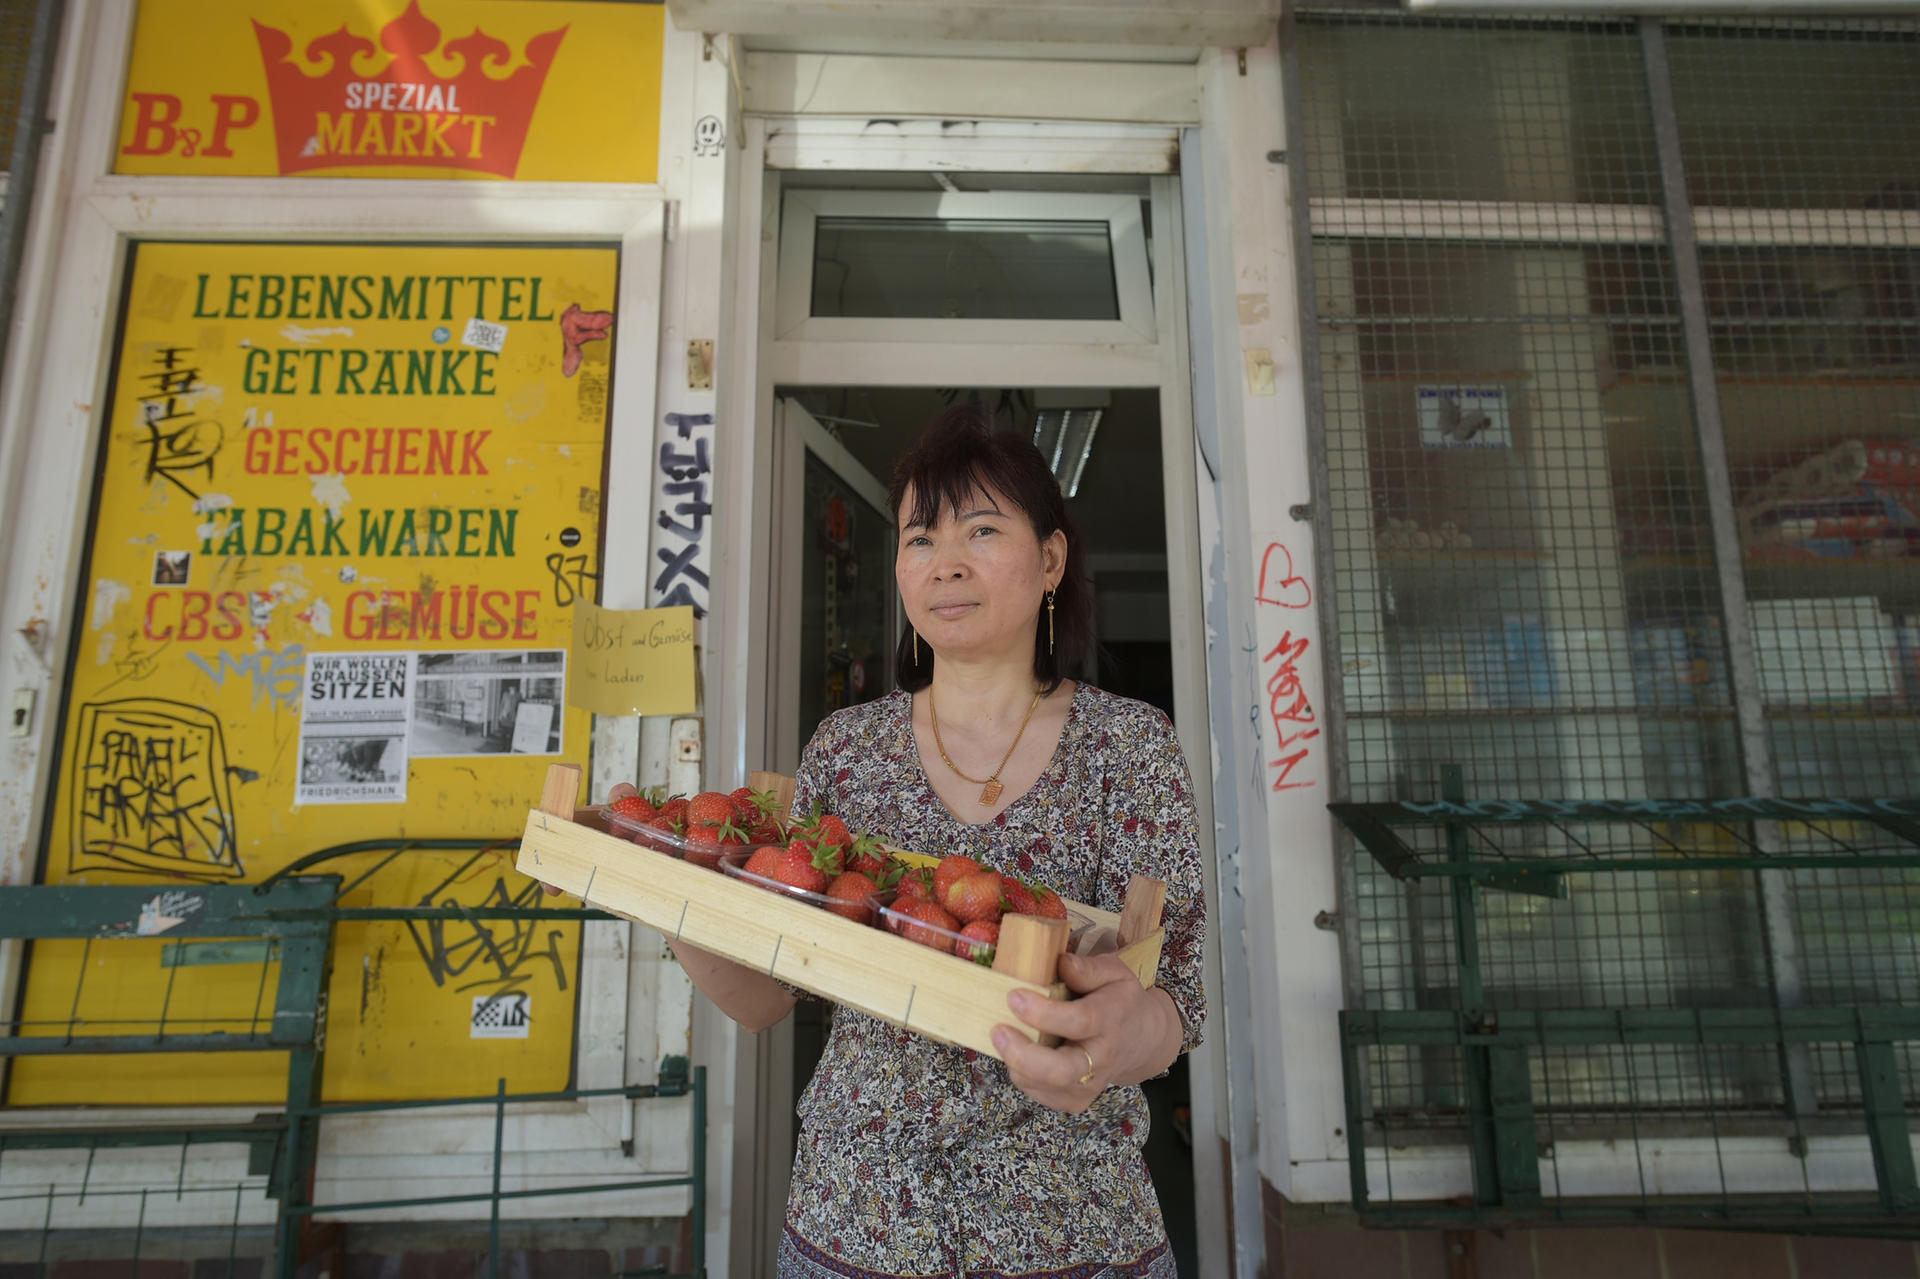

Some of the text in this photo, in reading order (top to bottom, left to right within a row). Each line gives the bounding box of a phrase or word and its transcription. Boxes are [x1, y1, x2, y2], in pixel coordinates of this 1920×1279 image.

[345, 82, 461, 113] SPEZIAL
[315, 111, 496, 159] MARKT
[192, 273, 555, 322] LEBENSMITTEL
[243, 347, 500, 396] GETRÄNKE
[244, 427, 493, 476] GESCHENK
[343, 585, 541, 641] GEMÜSE
[584, 612, 625, 651] Obst
[311, 669, 406, 682] DRAUSSEN
[313, 659, 341, 669] WIR
[347, 658, 406, 669] WOLLEN
[311, 681, 406, 700] SITZEN
